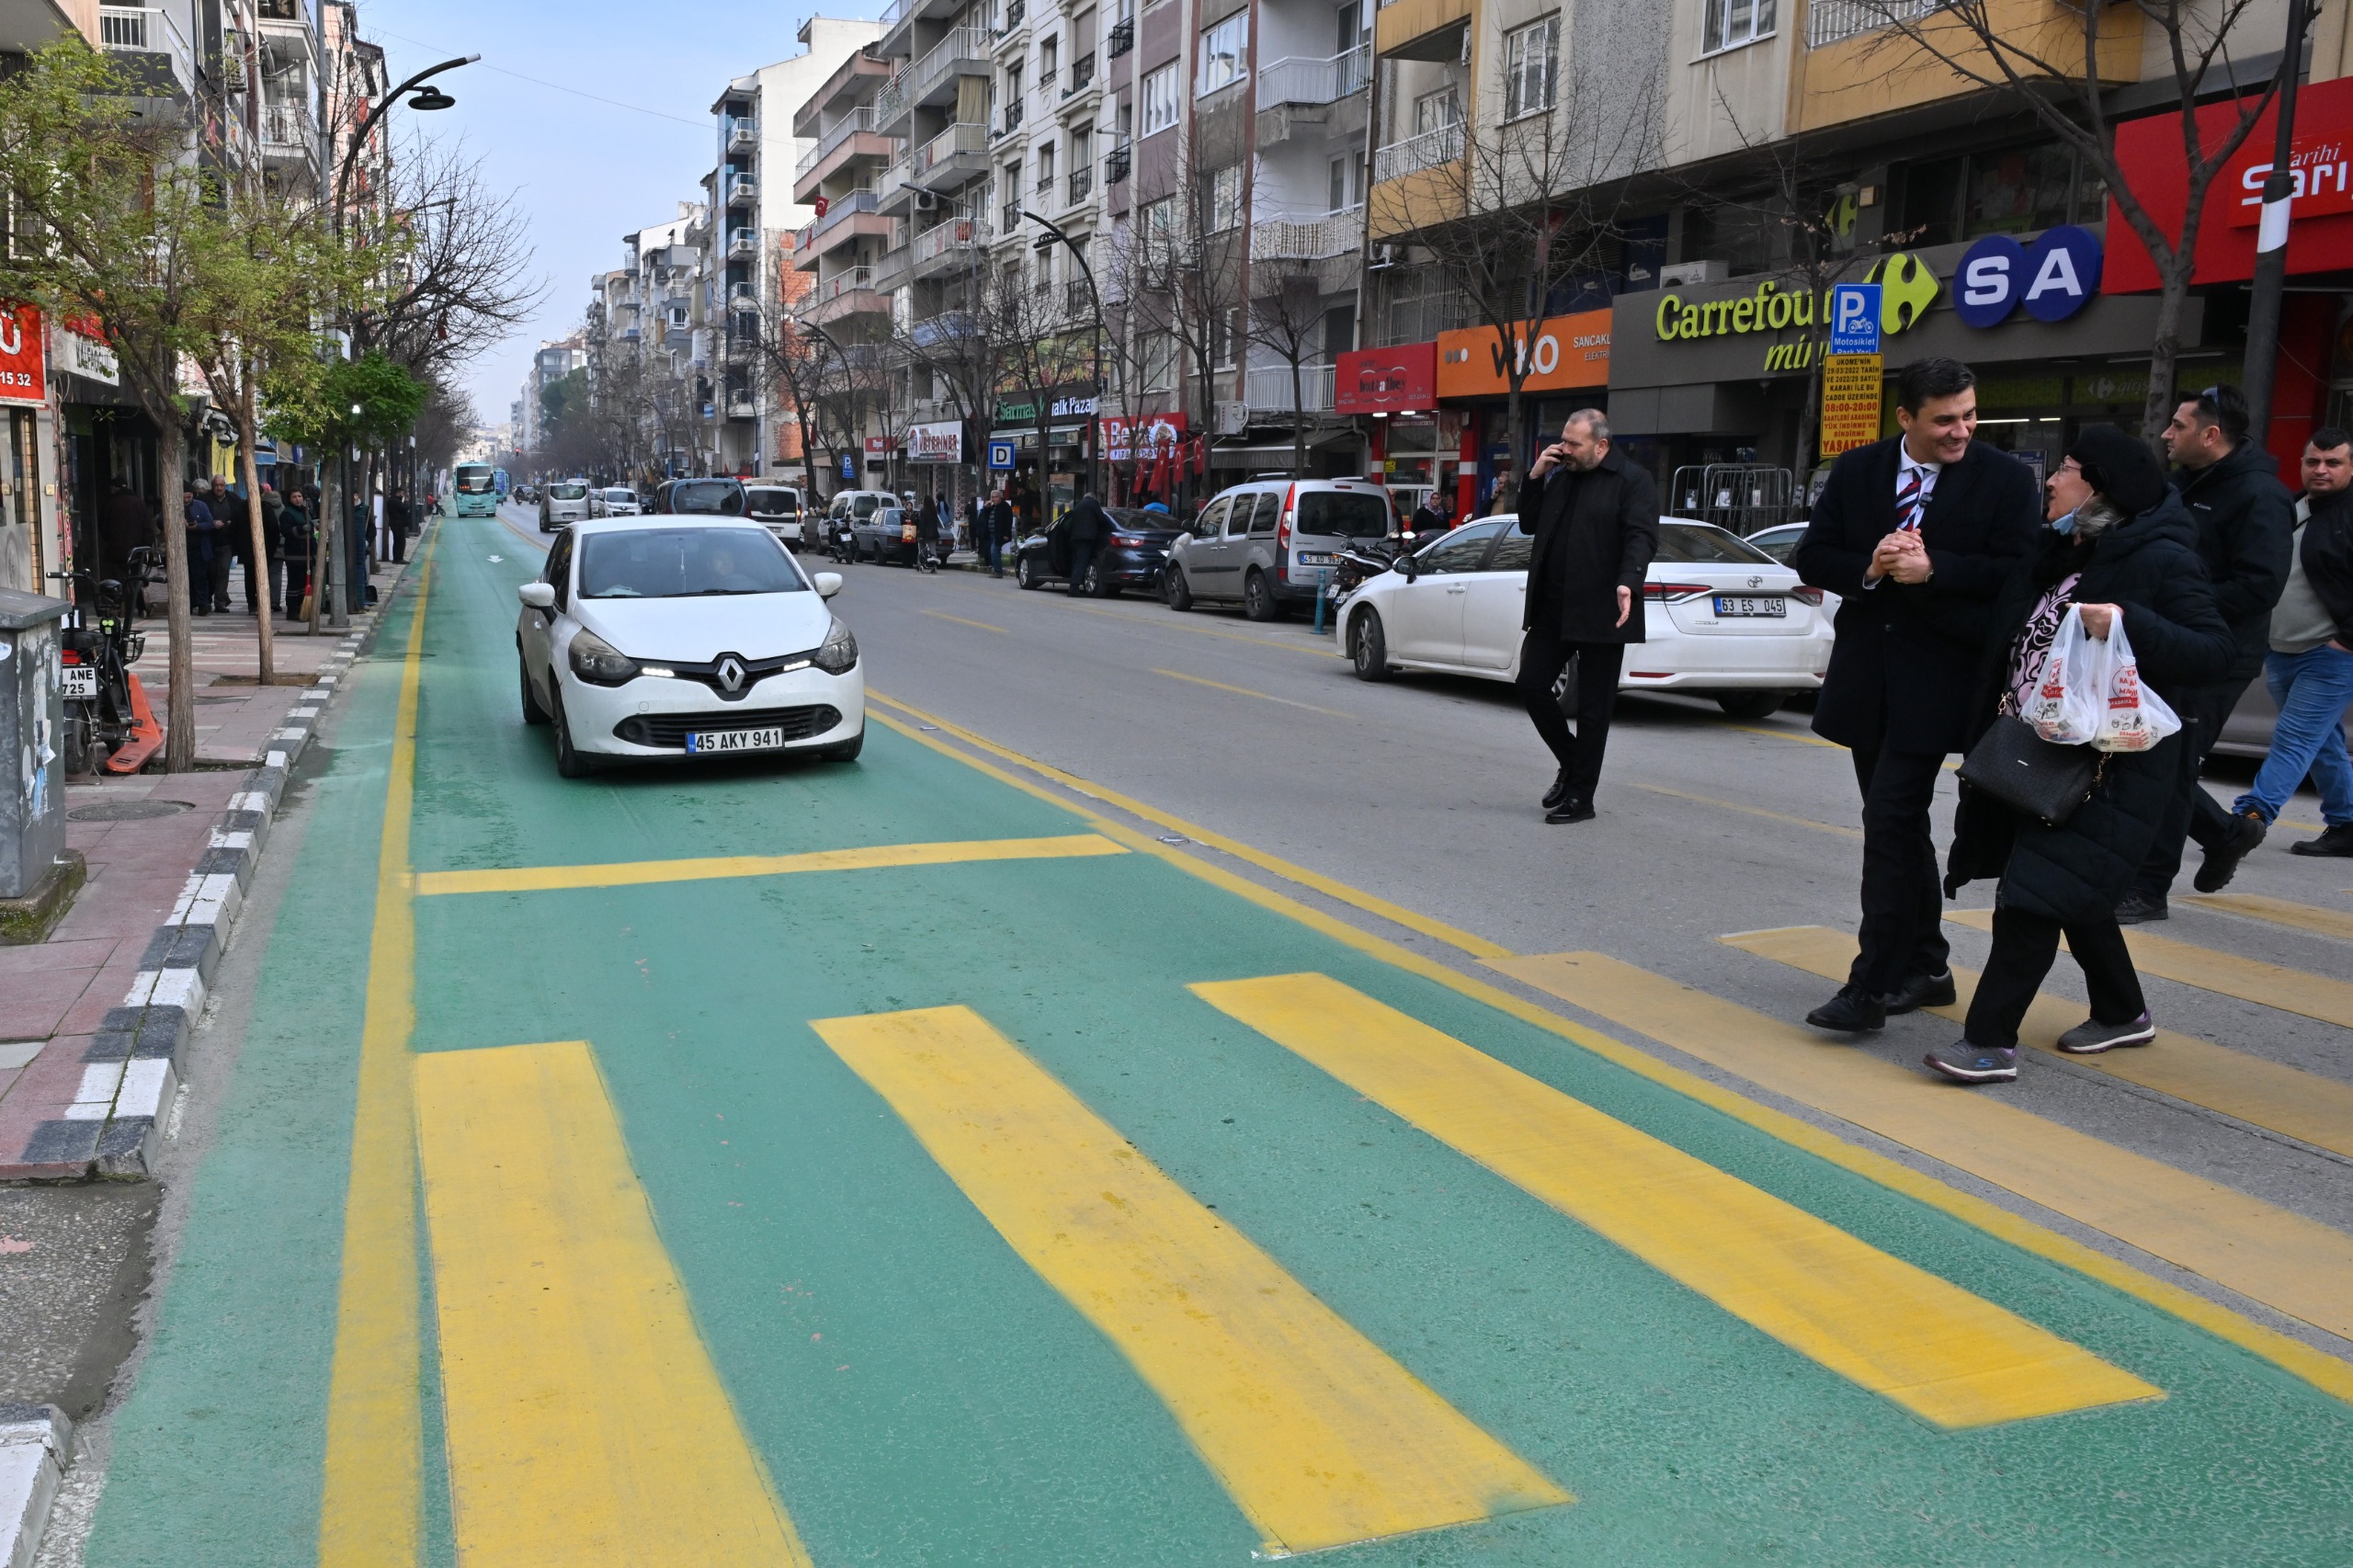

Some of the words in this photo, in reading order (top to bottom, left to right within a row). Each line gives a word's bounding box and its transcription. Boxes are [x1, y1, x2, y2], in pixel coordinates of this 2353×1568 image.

[1838, 291, 1865, 333] P
[1834, 337, 1875, 346] Motosiklet
[1491, 335, 1559, 379] VKO
[17, 372, 31, 387] 32
[1000, 396, 1045, 424] Sarmaşk
[1824, 403, 1878, 412] 08:00-20:00
[1824, 413, 1849, 421] SAATLERİ
[919, 431, 957, 451] VETERİNER
[996, 449, 1006, 462] D
[1814, 481, 1825, 489] DO
[1722, 599, 1734, 611] 63
[1742, 599, 1754, 612] ES
[1764, 600, 1782, 612] 045
[70, 669, 93, 680] ANE
[63, 684, 85, 694] 725
[697, 734, 715, 750] 45
[720, 733, 747, 749] AKY
[754, 730, 779, 746] 941
